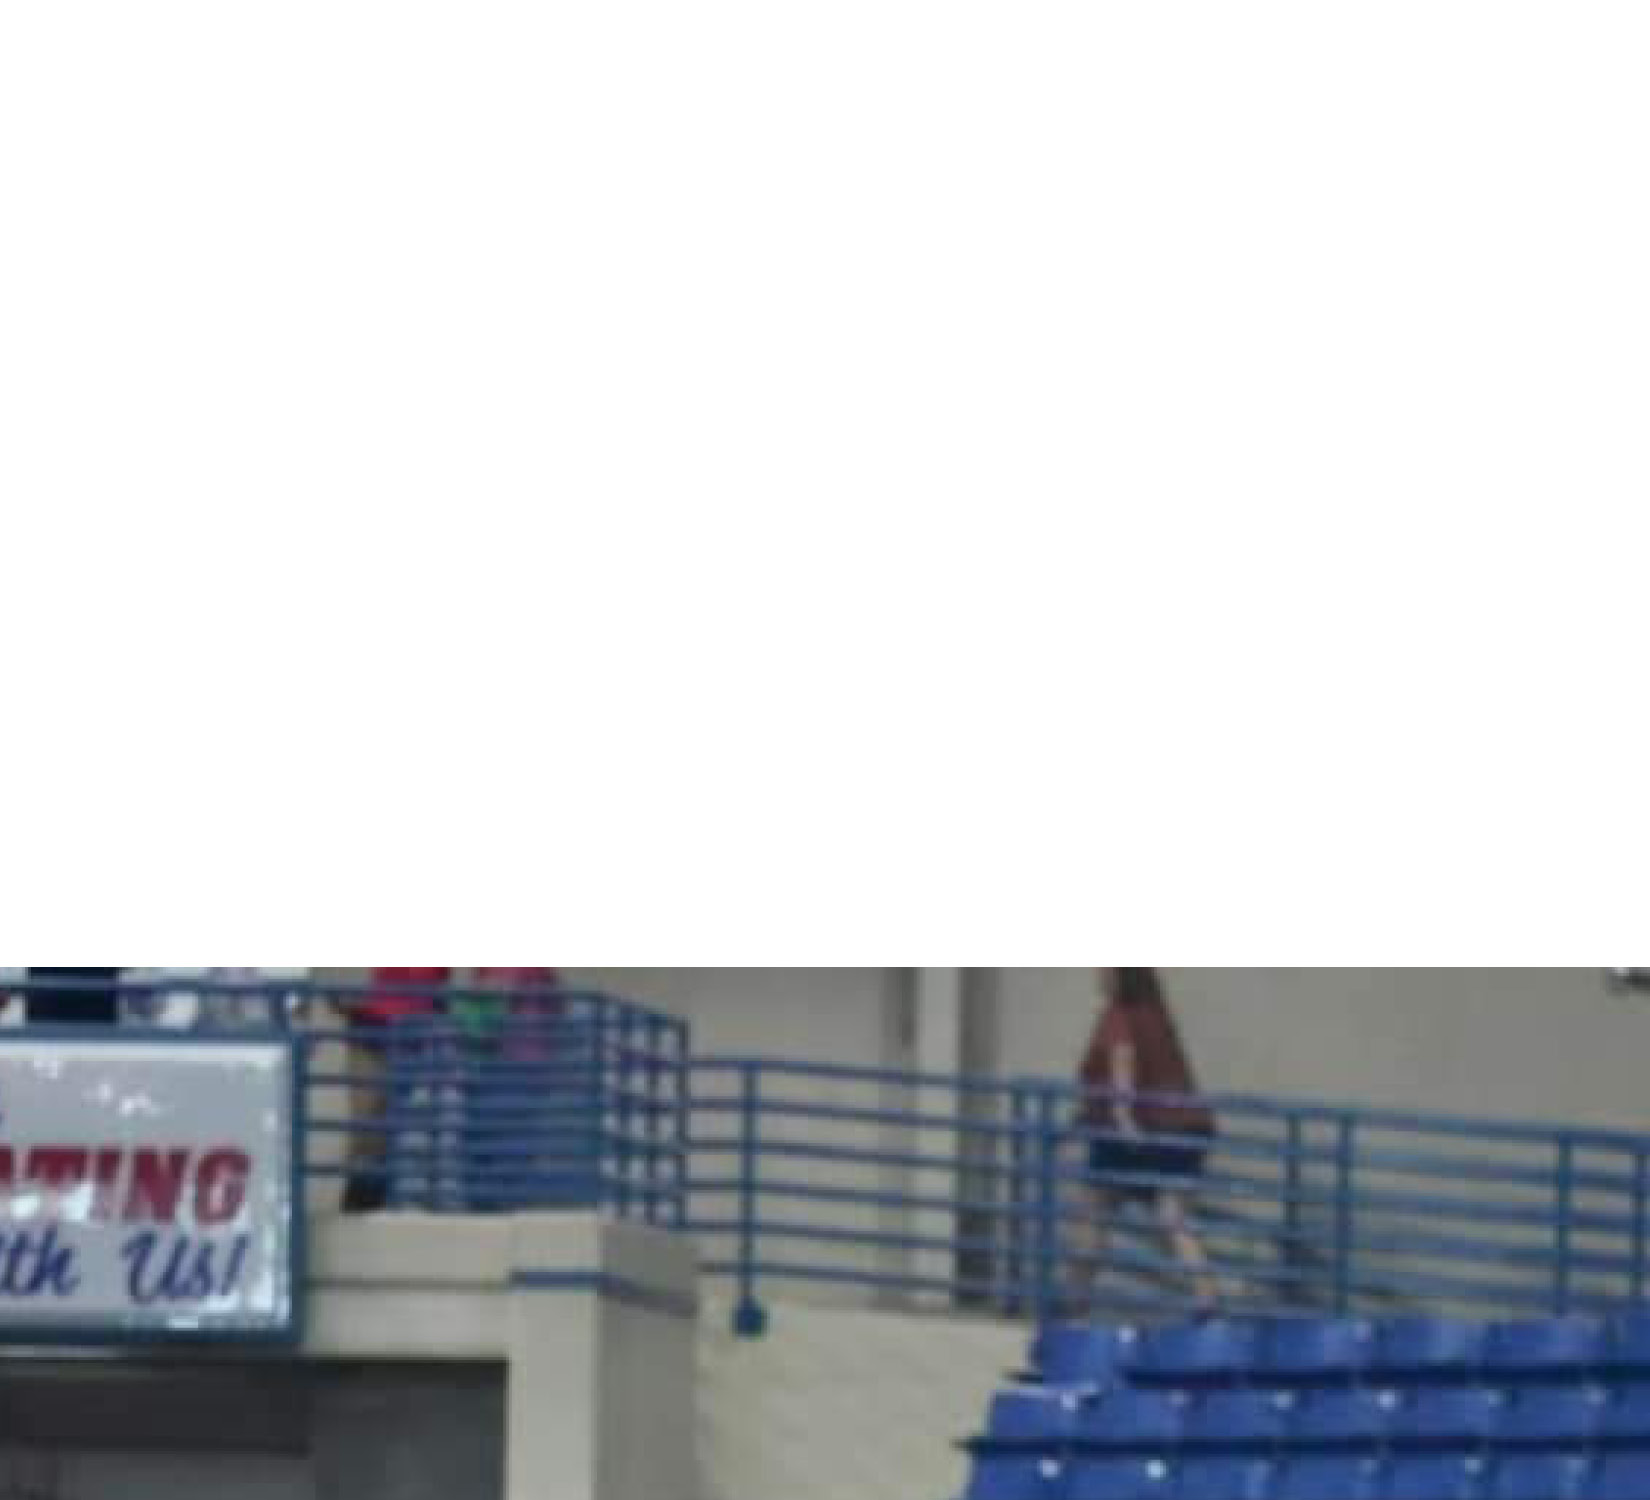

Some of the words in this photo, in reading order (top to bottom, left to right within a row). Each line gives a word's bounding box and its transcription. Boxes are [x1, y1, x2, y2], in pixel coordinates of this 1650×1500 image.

[0, 1144, 252, 1226] TING
[0, 1220, 80, 1297] th
[118, 1232, 250, 1304] Us!
